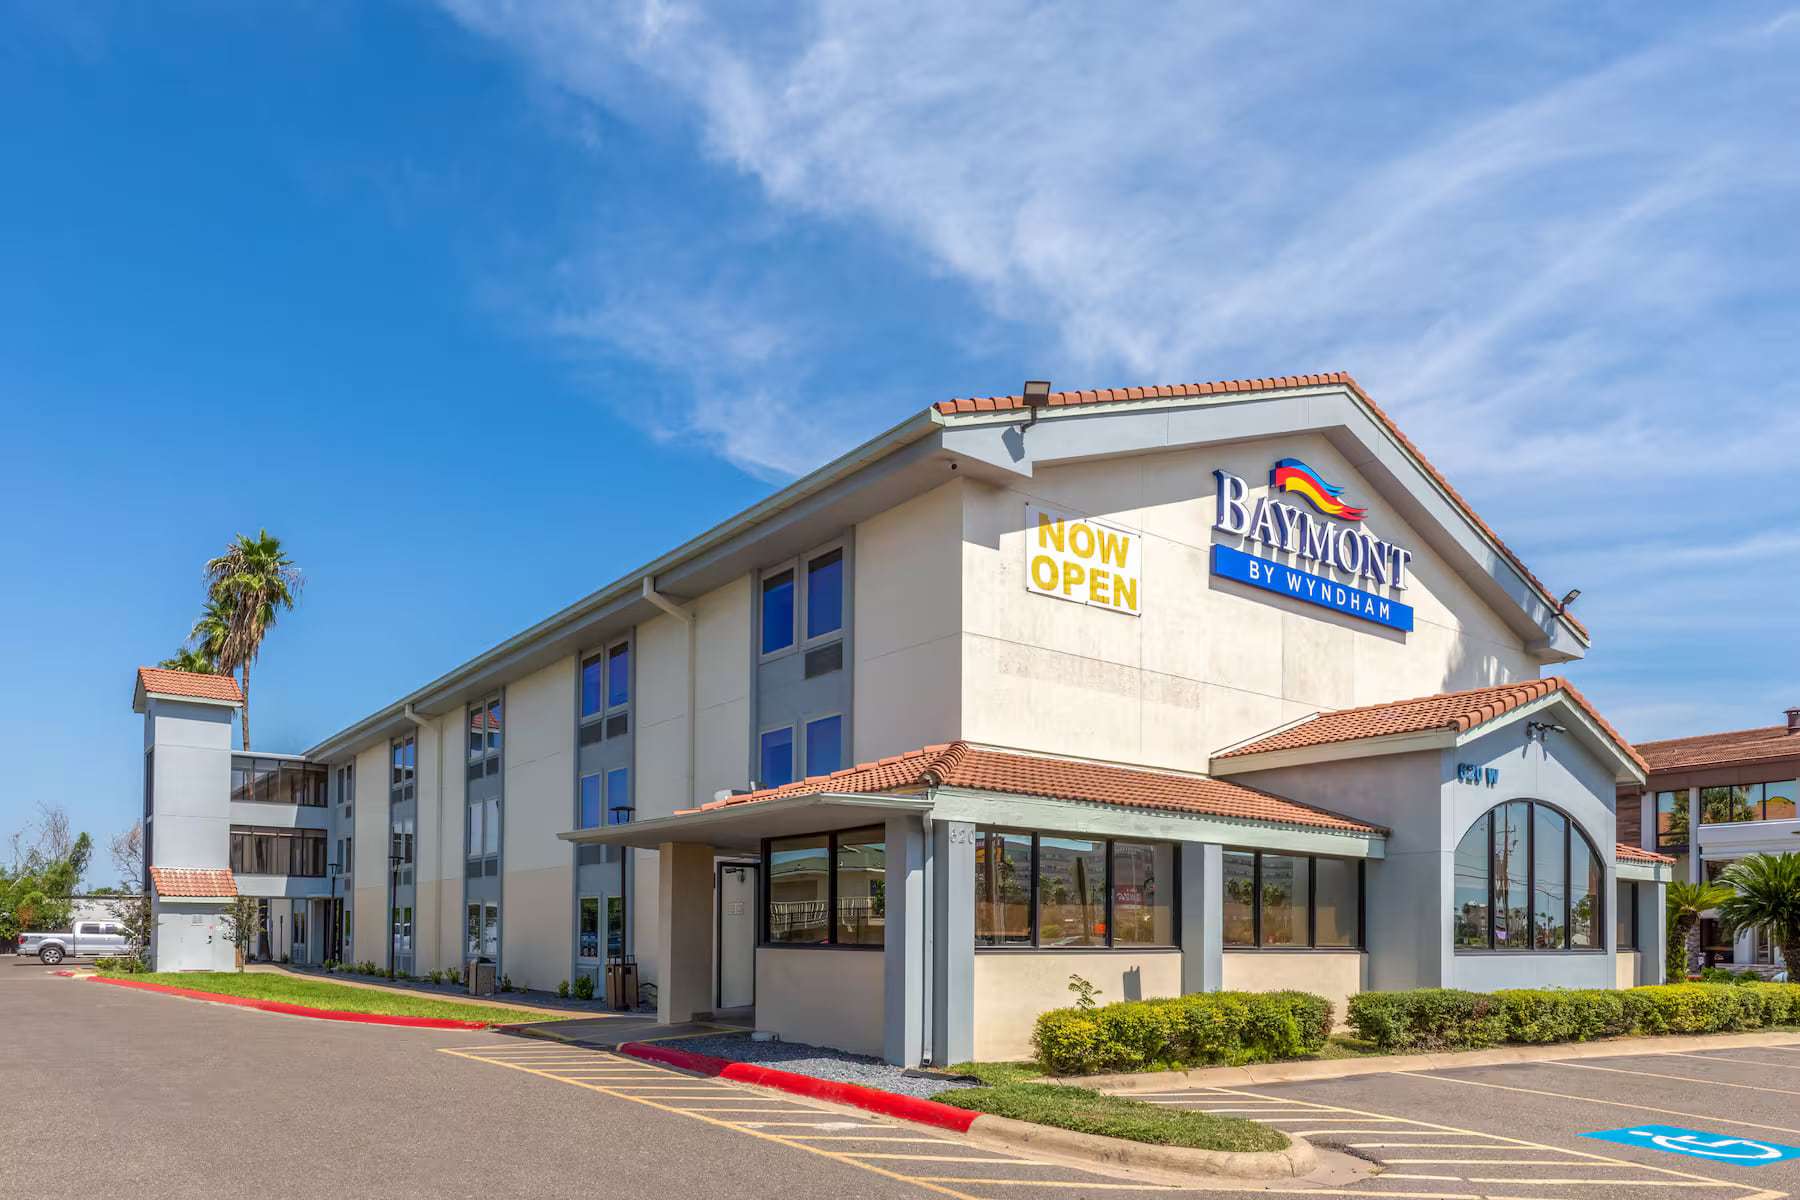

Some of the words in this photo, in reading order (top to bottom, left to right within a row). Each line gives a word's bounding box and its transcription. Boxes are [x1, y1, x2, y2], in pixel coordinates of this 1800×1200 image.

[1038, 511, 1130, 568] NOW
[1212, 469, 1412, 590] BAYMONT
[1031, 554, 1137, 611] OPEN
[1249, 559, 1275, 583] BY
[1286, 571, 1390, 620] WYNDHAM
